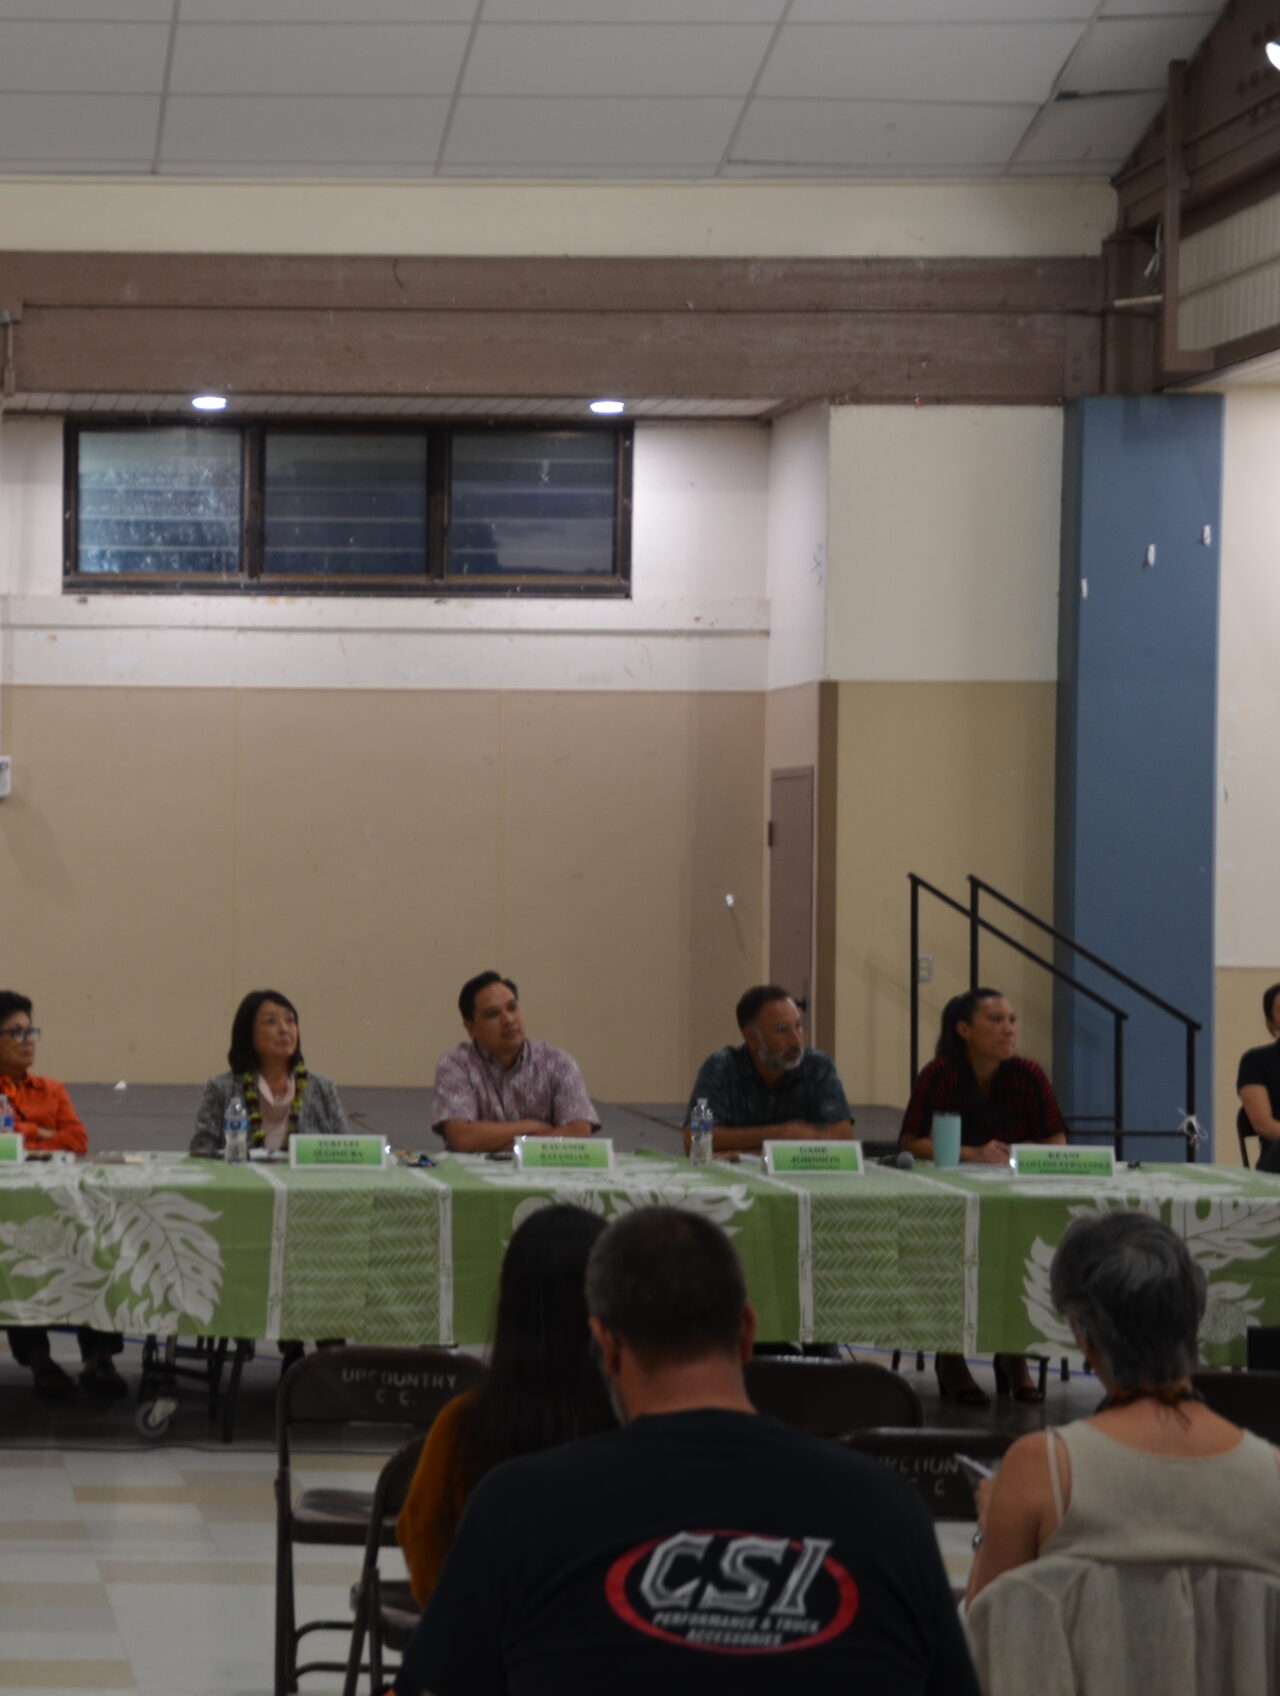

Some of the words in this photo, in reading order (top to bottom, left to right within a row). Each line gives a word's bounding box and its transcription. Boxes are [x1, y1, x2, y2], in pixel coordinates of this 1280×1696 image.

[341, 1367, 457, 1389] UPCOUNTRY
[640, 1531, 834, 1616] CSI
[652, 1610, 757, 1630] PERFORMANCE
[775, 1616, 821, 1634] TRUCK
[685, 1628, 783, 1647] ACCESSORIES
